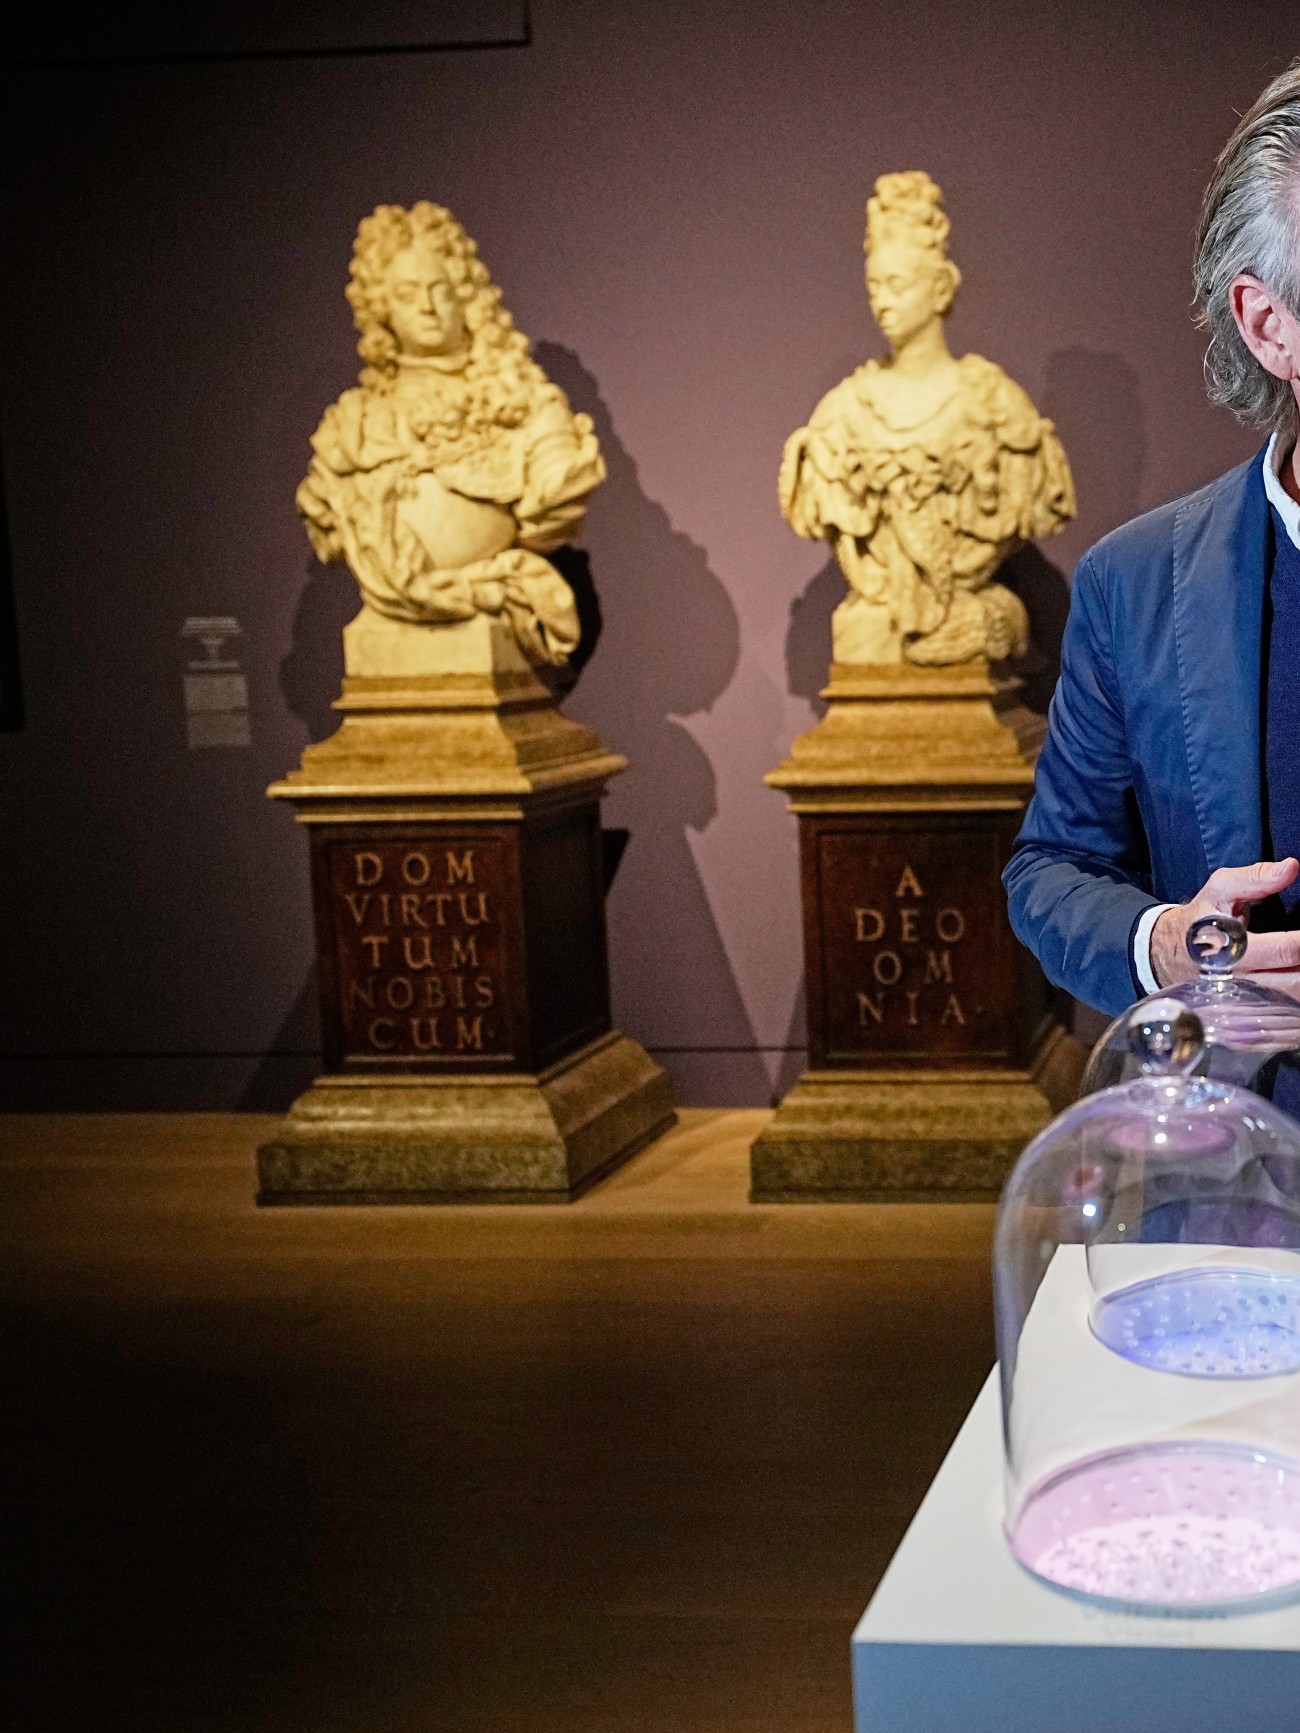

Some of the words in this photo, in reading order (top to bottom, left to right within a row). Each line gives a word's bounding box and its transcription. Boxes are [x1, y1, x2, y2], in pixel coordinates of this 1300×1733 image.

[354, 850, 476, 886] DOM
[895, 863, 925, 897] A
[345, 891, 492, 929] VIRTU
[854, 907, 967, 943] DEO
[361, 934, 480, 970] TUM
[873, 950, 954, 986] OM
[350, 975, 494, 1010] NOBIS
